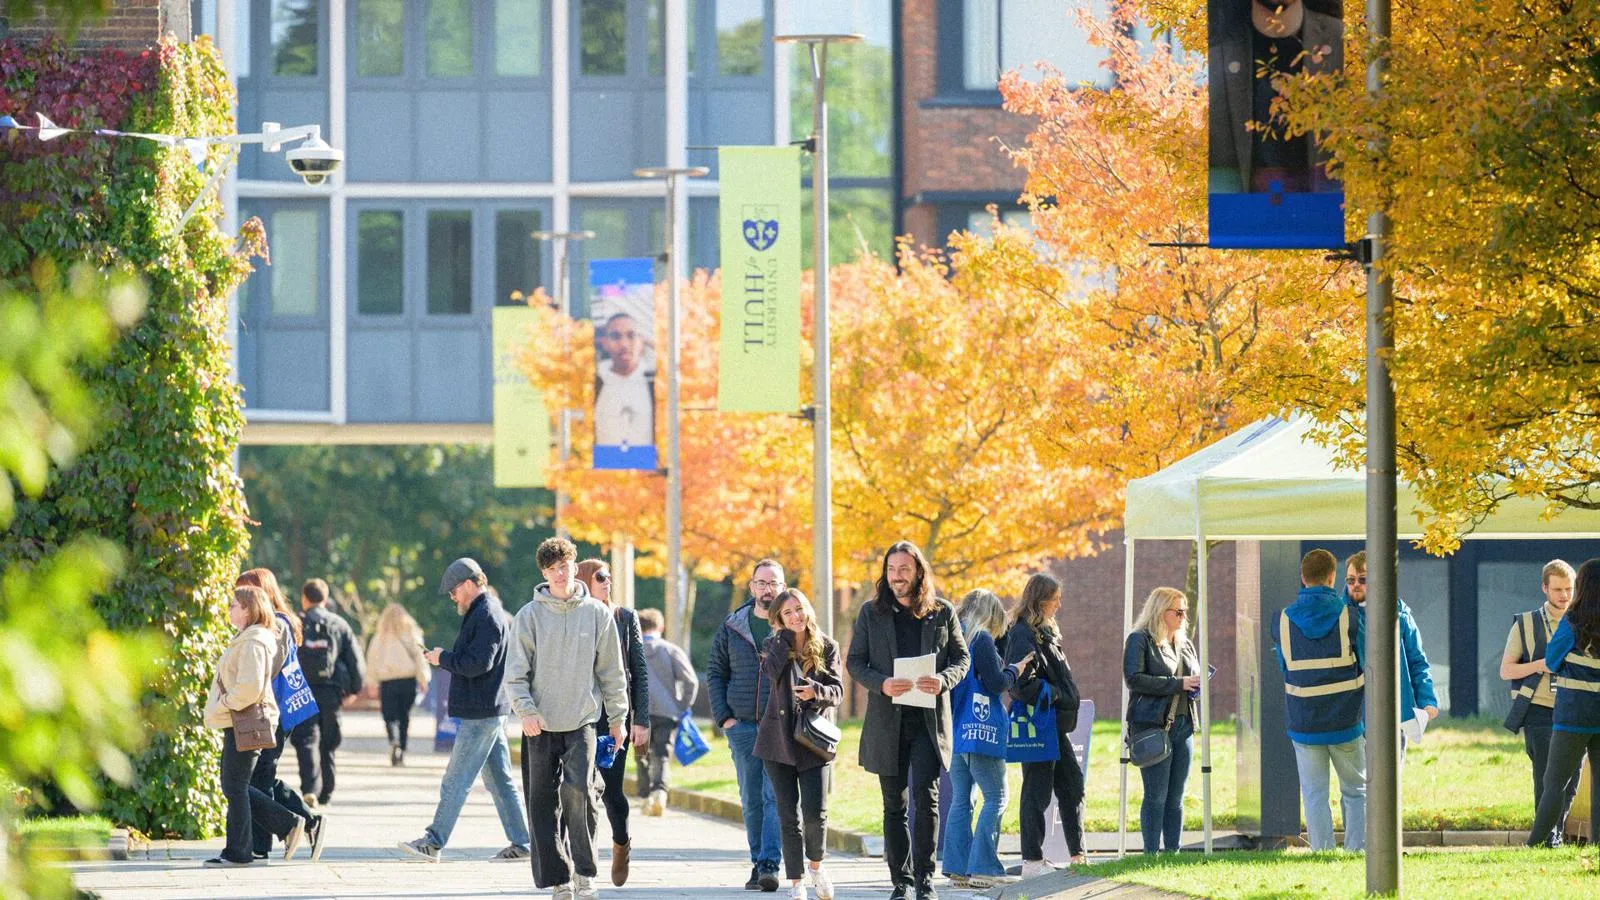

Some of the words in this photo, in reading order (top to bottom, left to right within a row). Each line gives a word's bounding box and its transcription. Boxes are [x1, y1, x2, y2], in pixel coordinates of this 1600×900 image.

[745, 256, 761, 271] of
[767, 258, 777, 349] UNIVERSITY
[744, 273, 765, 354] HULL
[291, 691, 315, 711] HUL
[962, 723, 998, 734] UNIVERSITY
[962, 732, 969, 741] of
[968, 729, 999, 745] HULL
